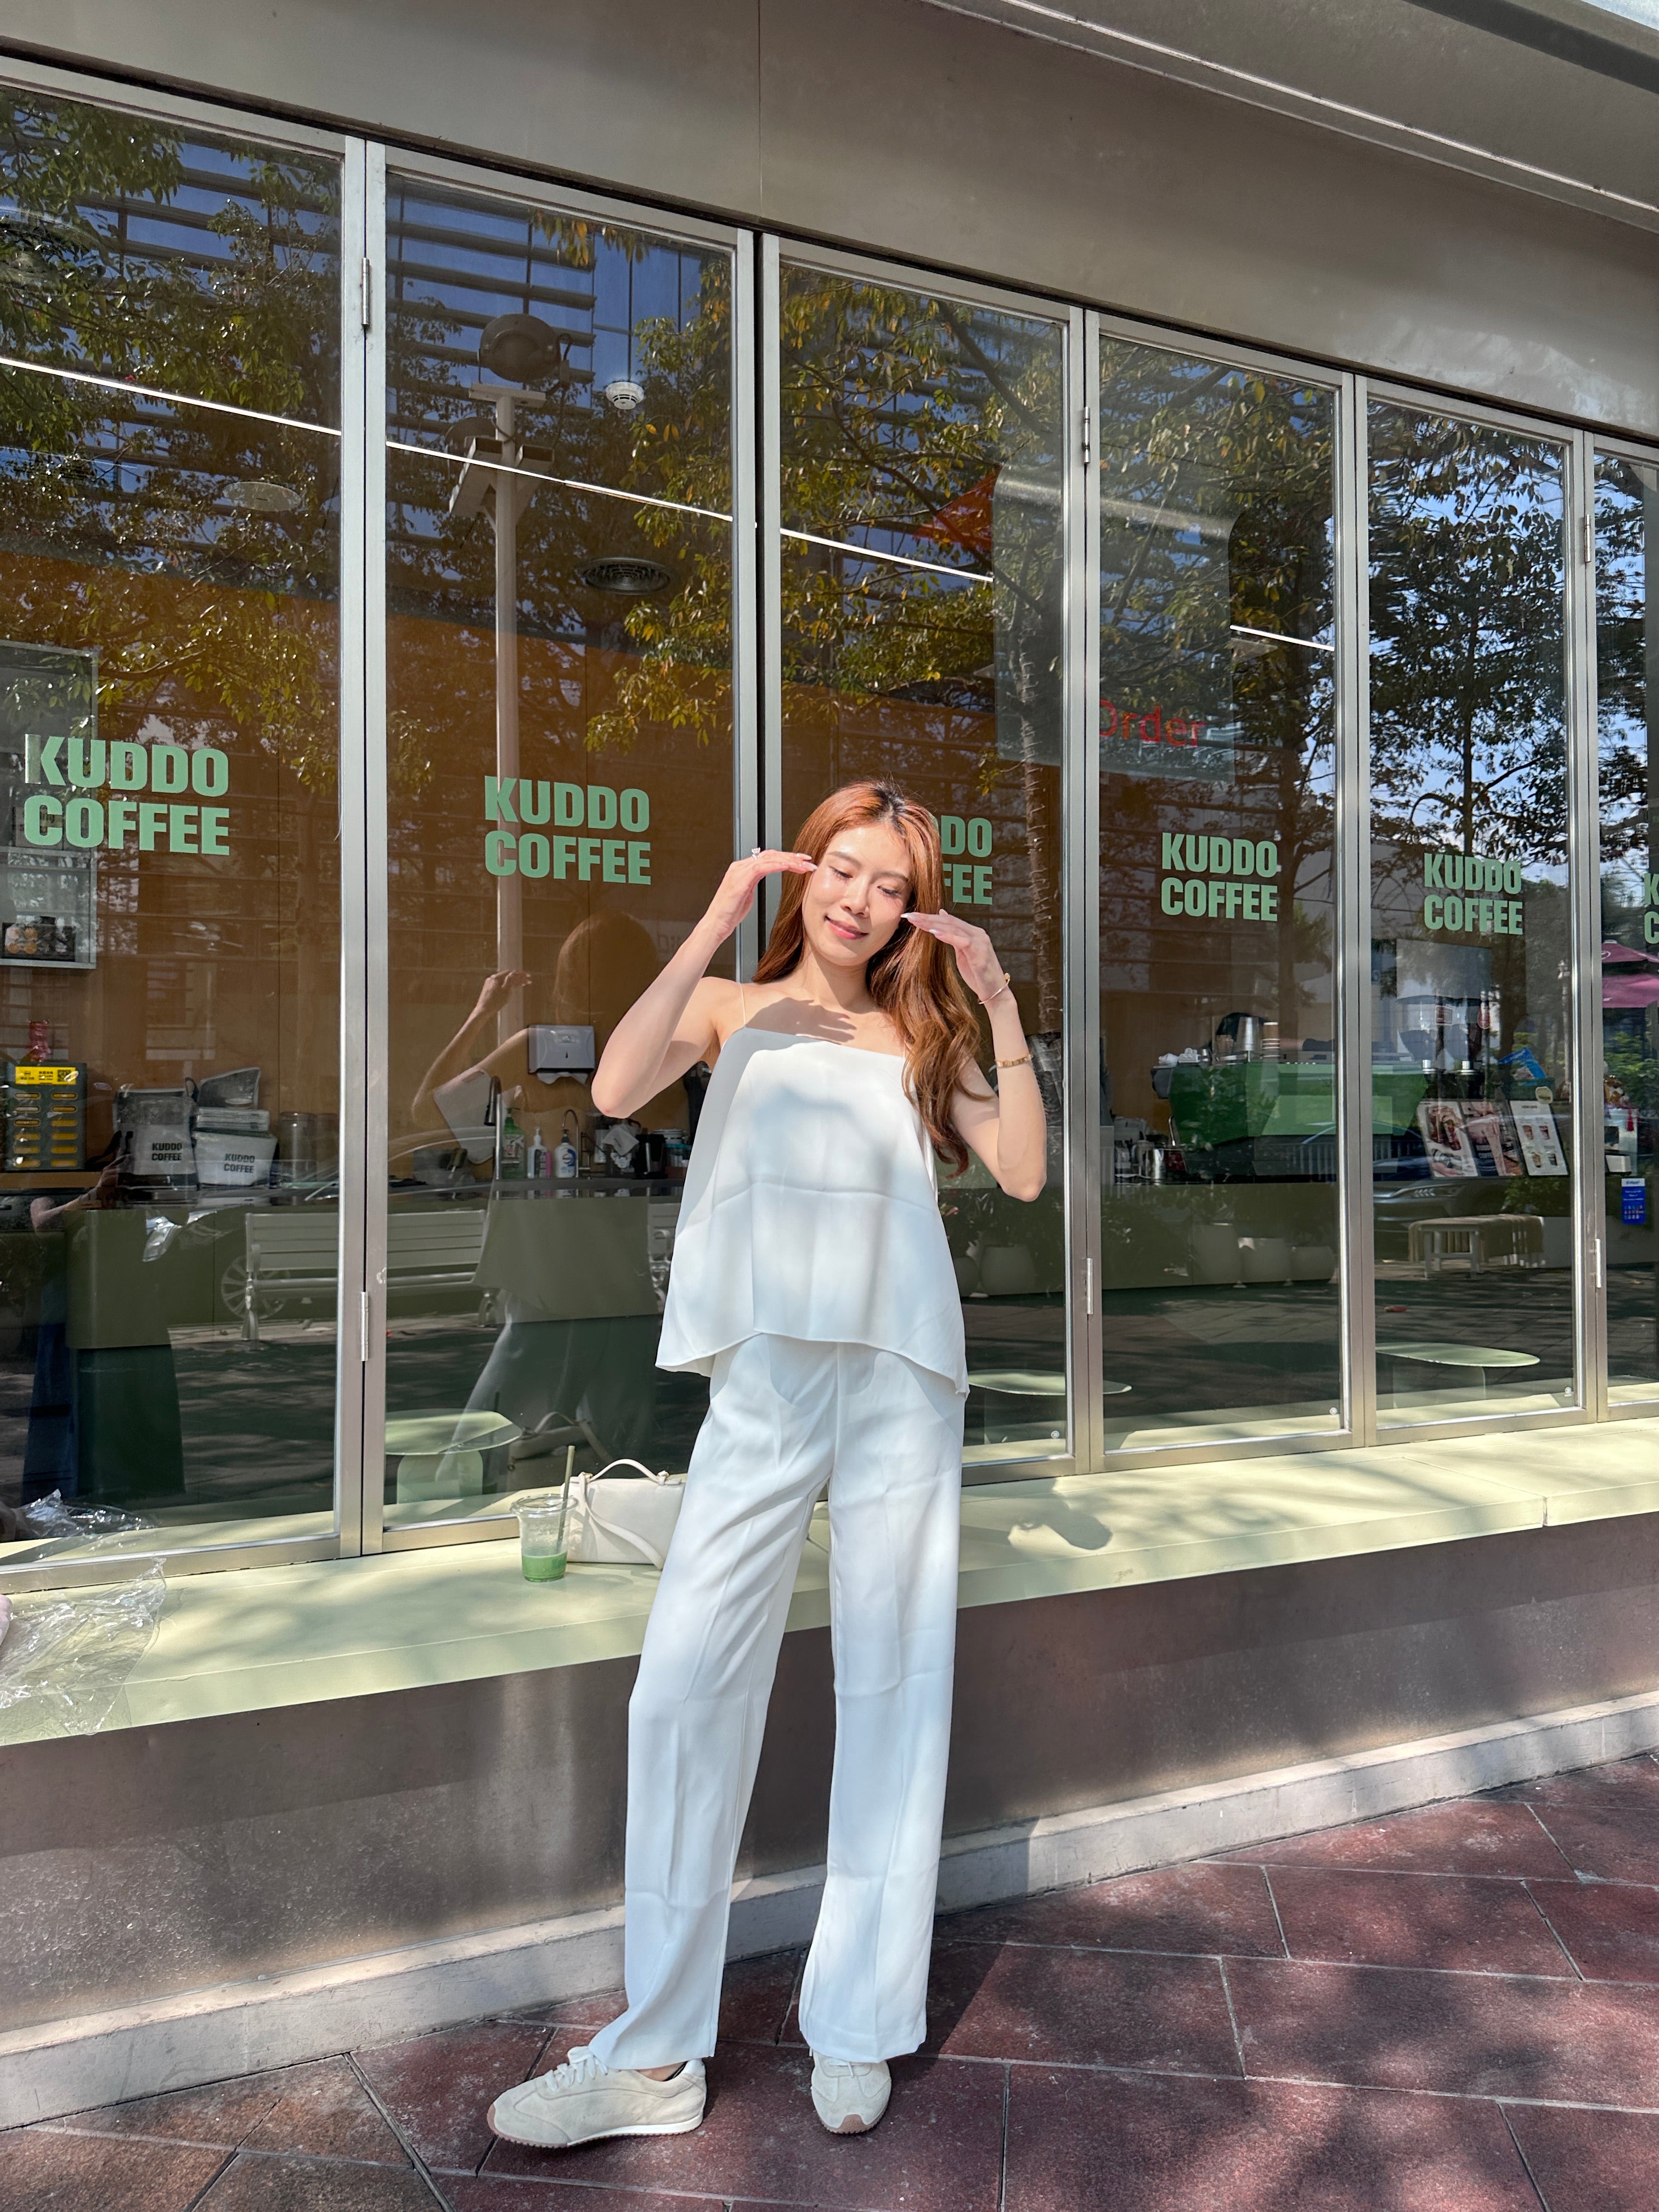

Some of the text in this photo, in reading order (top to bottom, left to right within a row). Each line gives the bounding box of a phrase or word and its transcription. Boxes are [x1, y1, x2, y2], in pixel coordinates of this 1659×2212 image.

[25, 734, 229, 797] KUDDO
[24, 795, 229, 856] COFFEE
[484, 776, 650, 832] KUDDO
[485, 830, 651, 885] COFFEE
[1162, 832, 1278, 877] KUDDO
[1424, 853, 1522, 894] KUDDO
[1161, 877, 1278, 922] COFFEE
[1424, 894, 1523, 935] COFFEE
[151, 1153, 182, 1161] COFFEE
[152, 1142, 183, 1151] KUDDO
[224, 1163, 254, 1173] COFFEE
[225, 1153, 255, 1163] KUDDO
